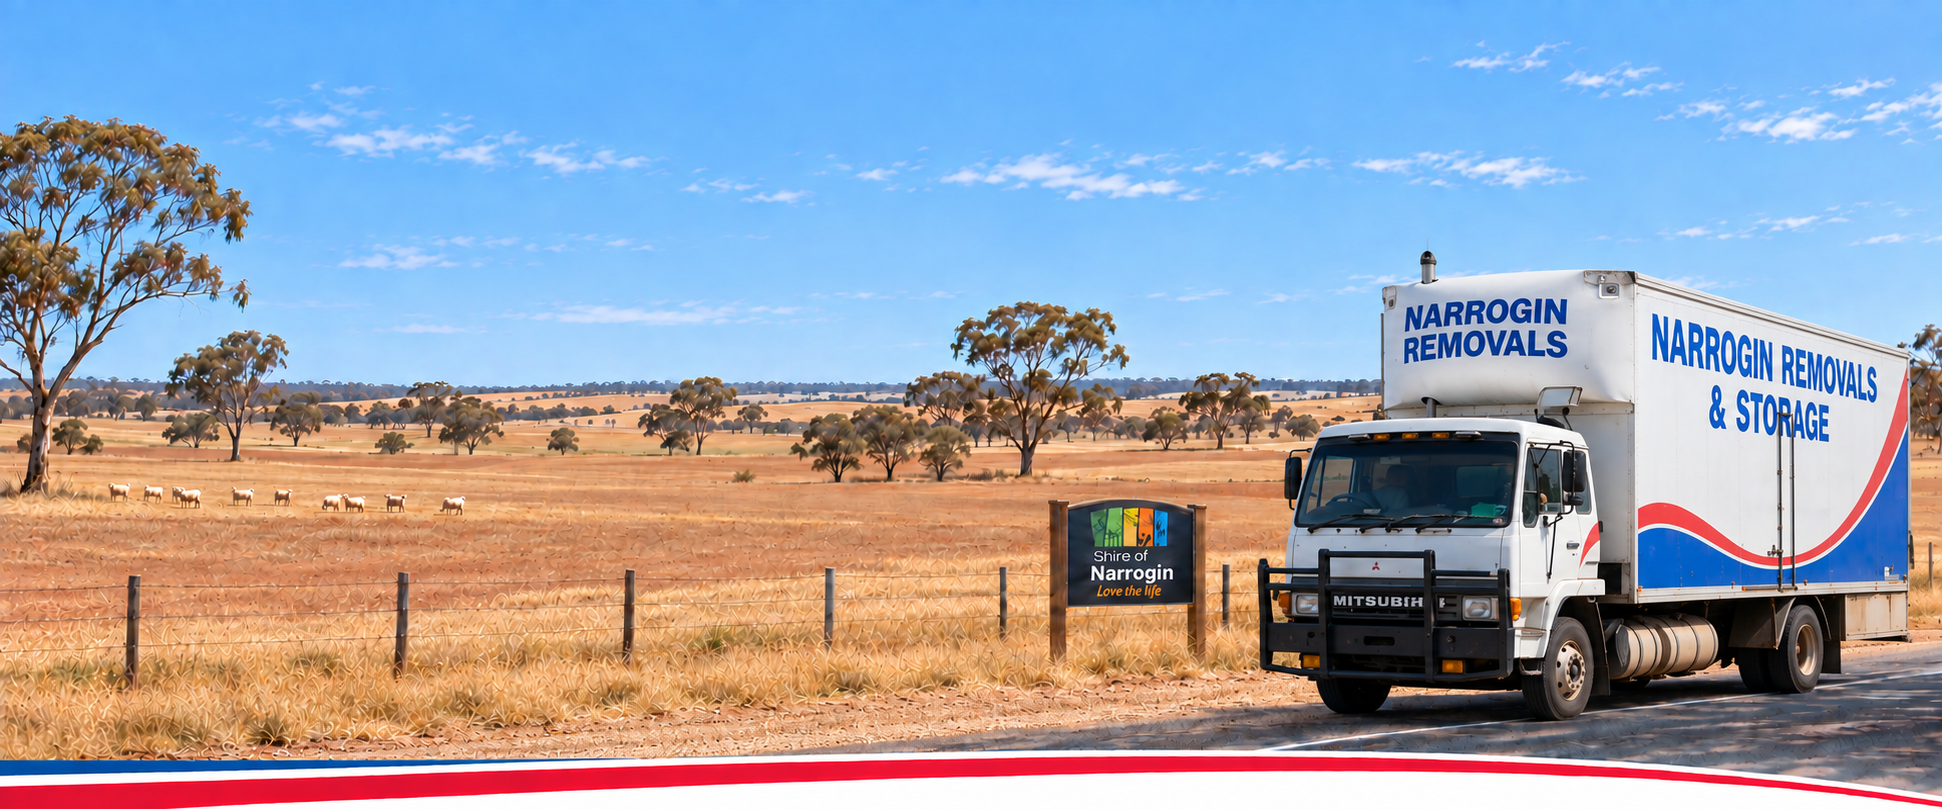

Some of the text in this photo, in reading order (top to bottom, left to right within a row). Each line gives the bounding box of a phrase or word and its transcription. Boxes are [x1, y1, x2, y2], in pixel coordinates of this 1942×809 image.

[1404, 298, 1568, 332] NARROGIN
[1403, 330, 1568, 364] REMOVALS
[1651, 313, 1878, 403] NARROGIN REMOVALS
[1709, 384, 1830, 443] & STORAGE
[1093, 549, 1149, 562] Shire of
[1090, 564, 1174, 584] Narrogin
[1096, 584, 1162, 599] Love the life
